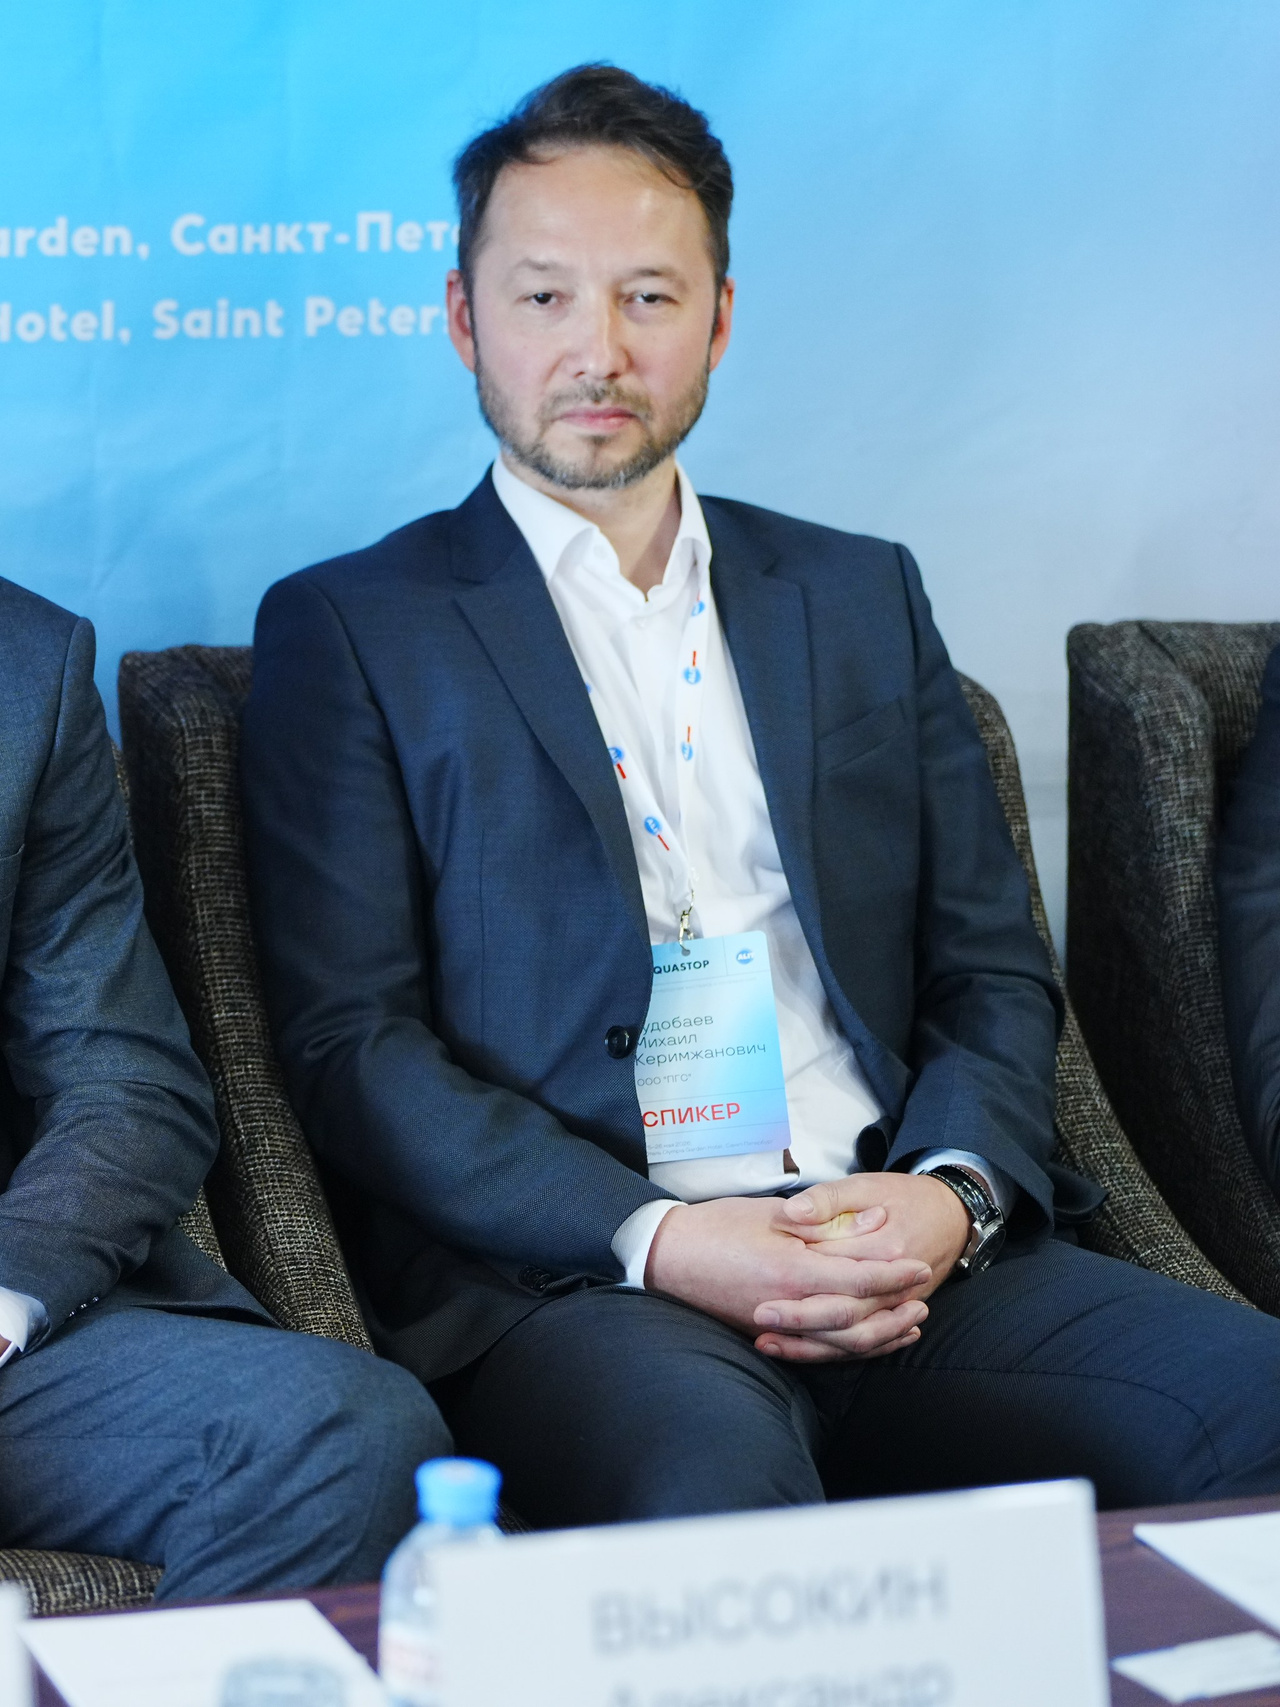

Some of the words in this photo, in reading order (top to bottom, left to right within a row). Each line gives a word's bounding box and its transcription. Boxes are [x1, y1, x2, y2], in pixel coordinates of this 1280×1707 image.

[170, 211, 460, 258] Санкт-Пет
[152, 300, 283, 338] Saint
[307, 296, 447, 336] Peter
[637, 1033, 698, 1049] Михаил
[635, 1043, 767, 1067] Керимжанович
[636, 1076, 661, 1087] ООО
[663, 1073, 692, 1084] "ПГС"
[642, 1102, 741, 1128] СПИКЕР
